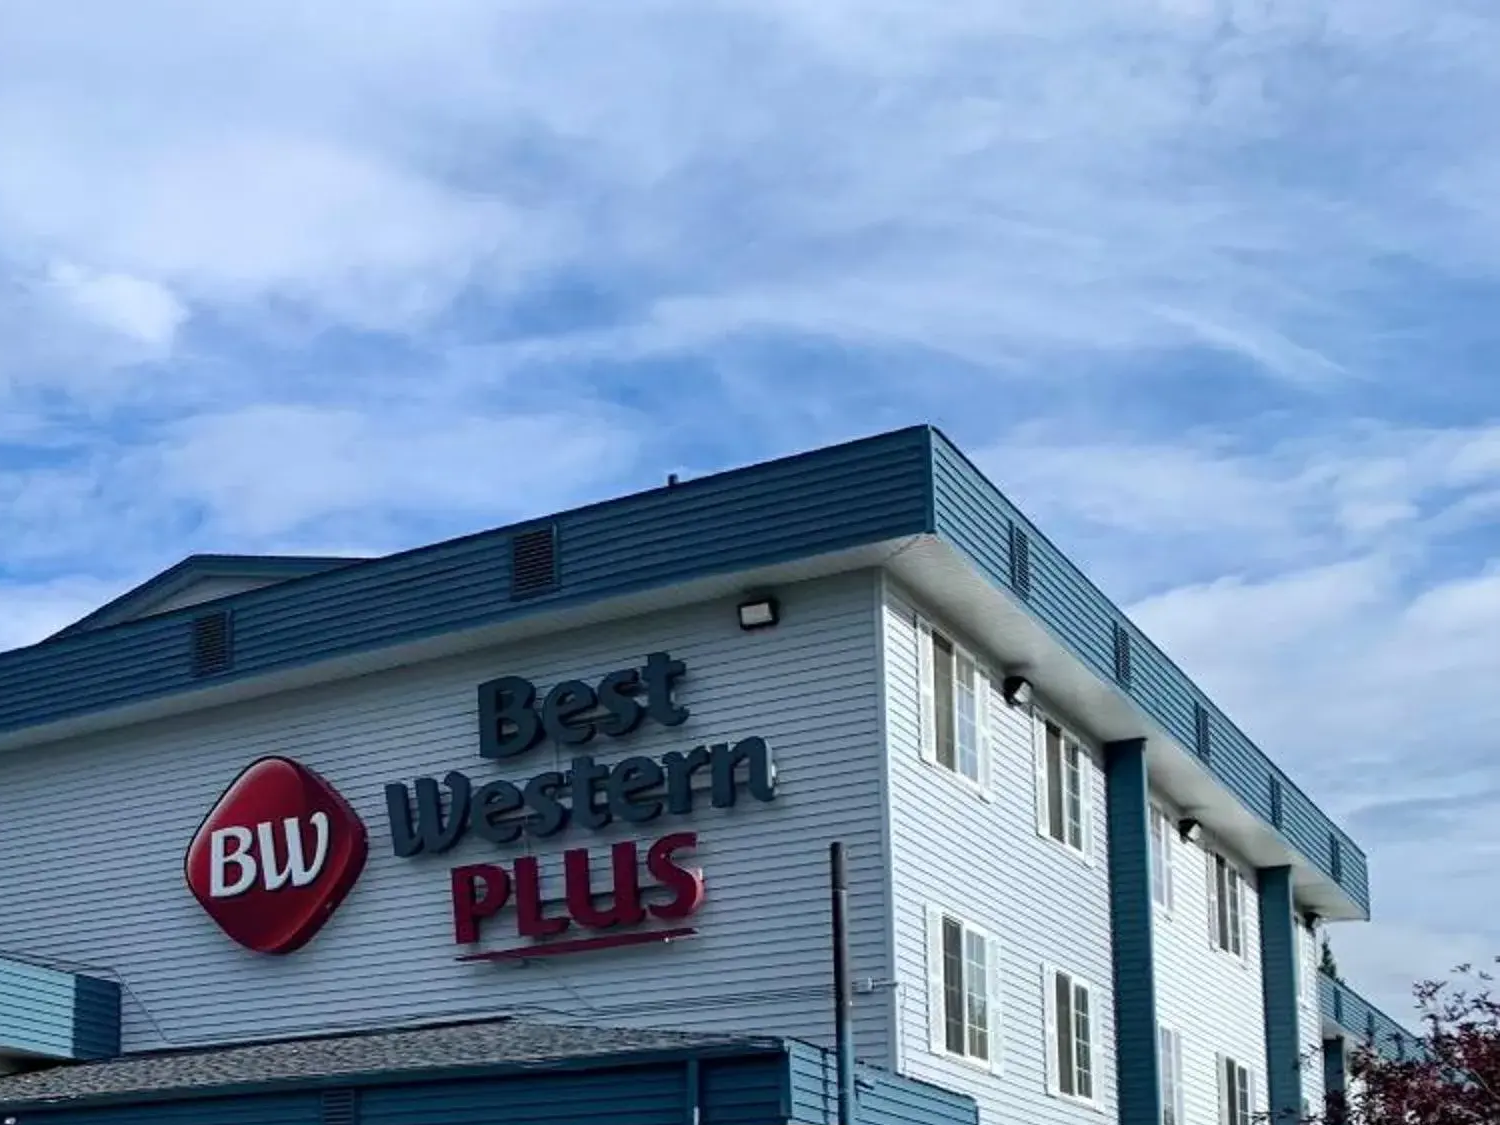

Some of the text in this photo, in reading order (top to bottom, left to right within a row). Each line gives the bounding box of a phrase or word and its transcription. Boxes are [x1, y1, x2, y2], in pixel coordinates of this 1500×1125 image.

[478, 652, 689, 759] Best
[385, 736, 780, 857] Western
[209, 811, 330, 898] BW
[451, 832, 705, 944] PLUS
